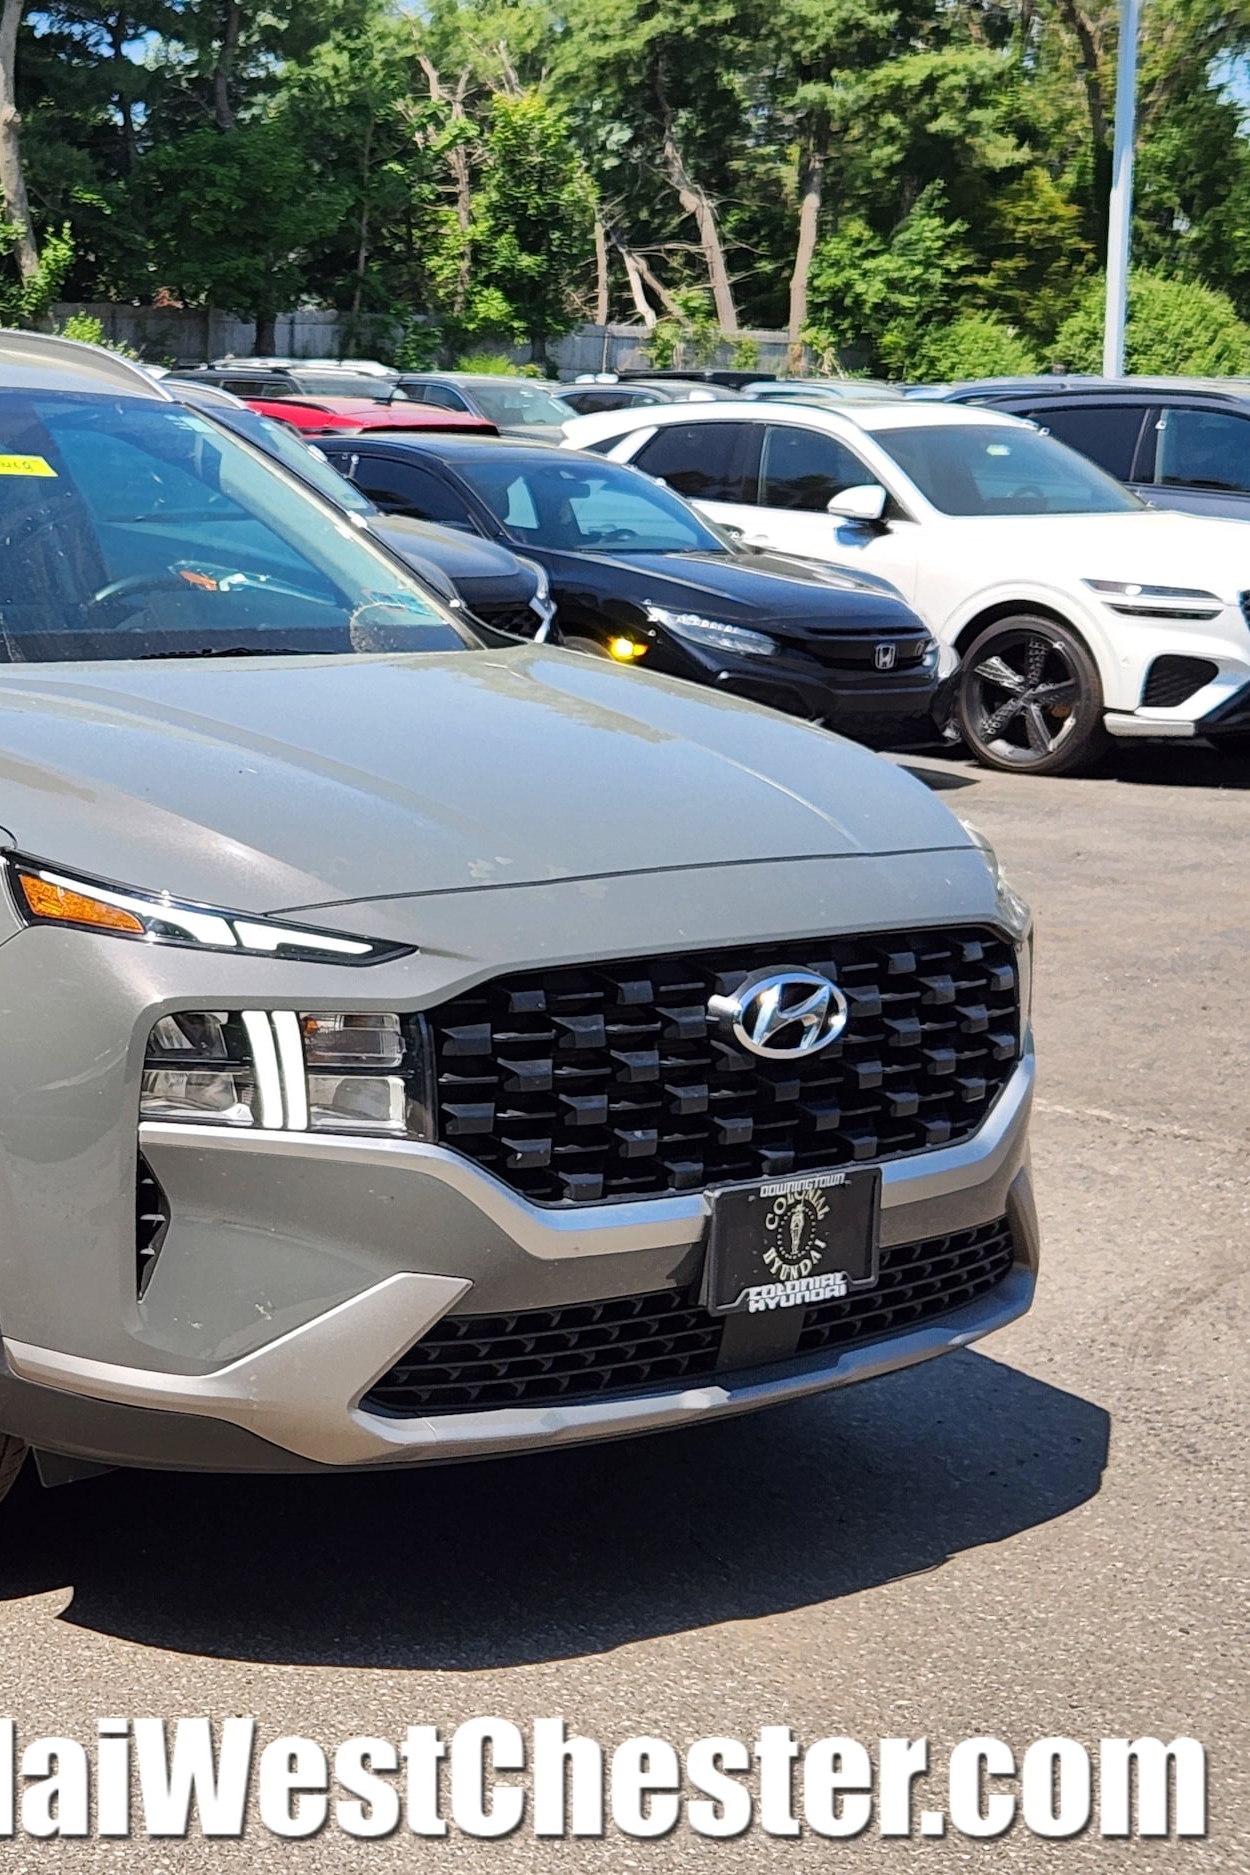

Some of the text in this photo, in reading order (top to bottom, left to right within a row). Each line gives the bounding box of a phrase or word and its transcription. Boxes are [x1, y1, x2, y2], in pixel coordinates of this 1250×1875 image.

[760, 1173, 846, 1198] DOWNINGTOWN
[765, 1188, 830, 1231] COLONIAL
[763, 1239, 827, 1281] HYUNDAI
[748, 1271, 847, 1301] COLONIAL
[748, 1283, 847, 1313] HYUNDAI
